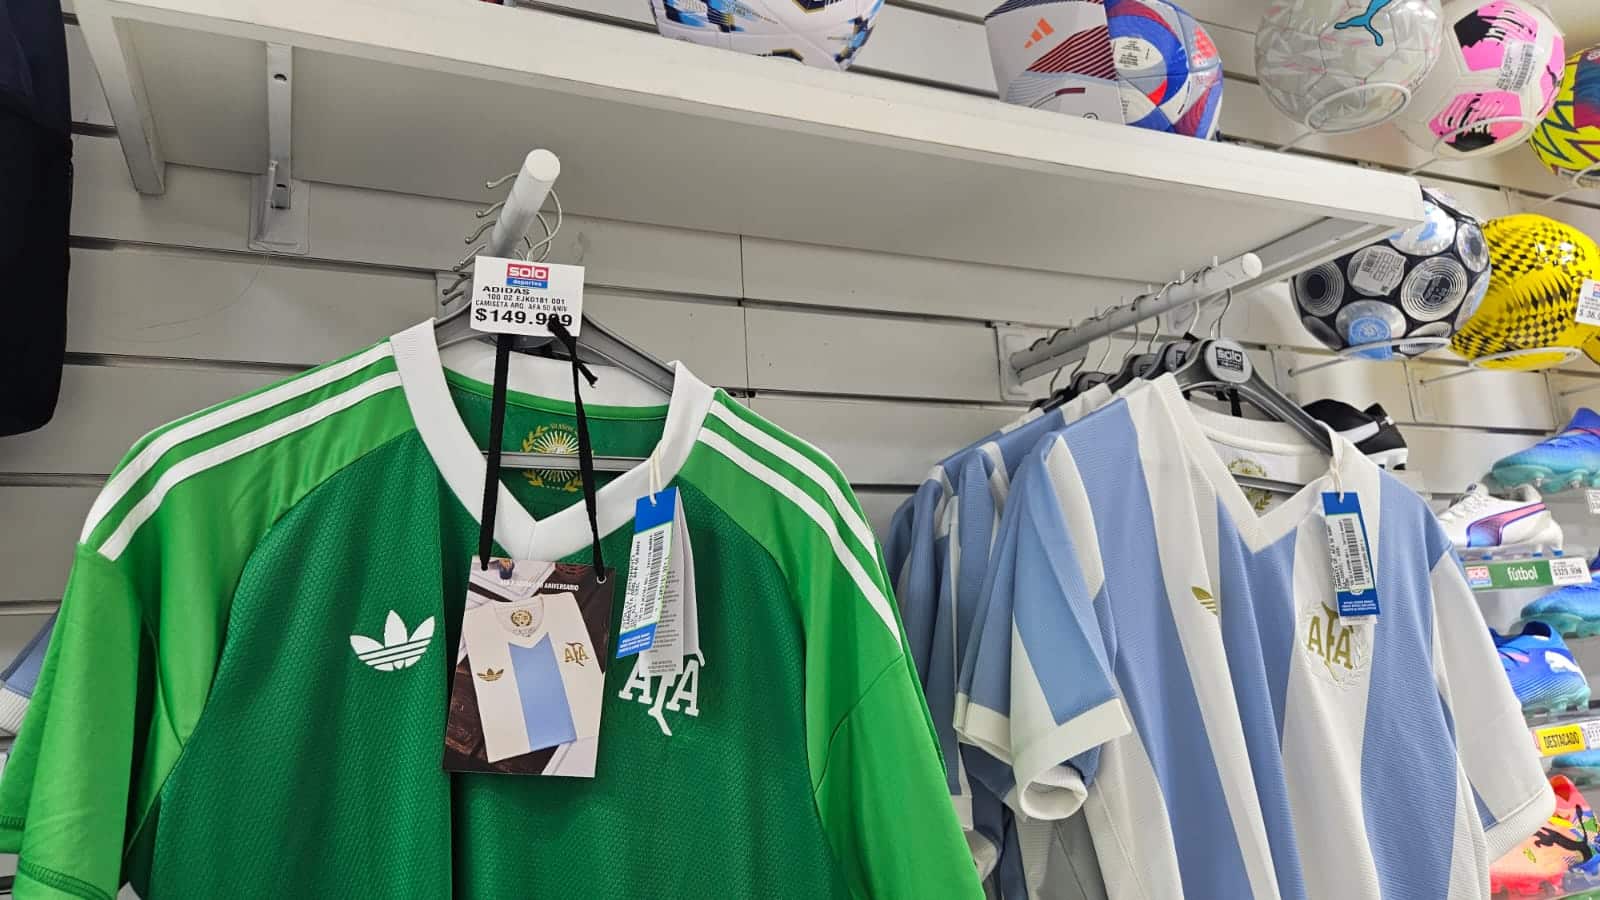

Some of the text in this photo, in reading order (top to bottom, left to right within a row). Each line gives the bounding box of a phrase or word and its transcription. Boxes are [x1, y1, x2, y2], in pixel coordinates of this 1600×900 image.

[508, 266, 547, 279] solo
[482, 286, 531, 296] ADIDAS
[1507, 566, 1539, 581] fútbol
[1543, 731, 1580, 749] DESTACADO
